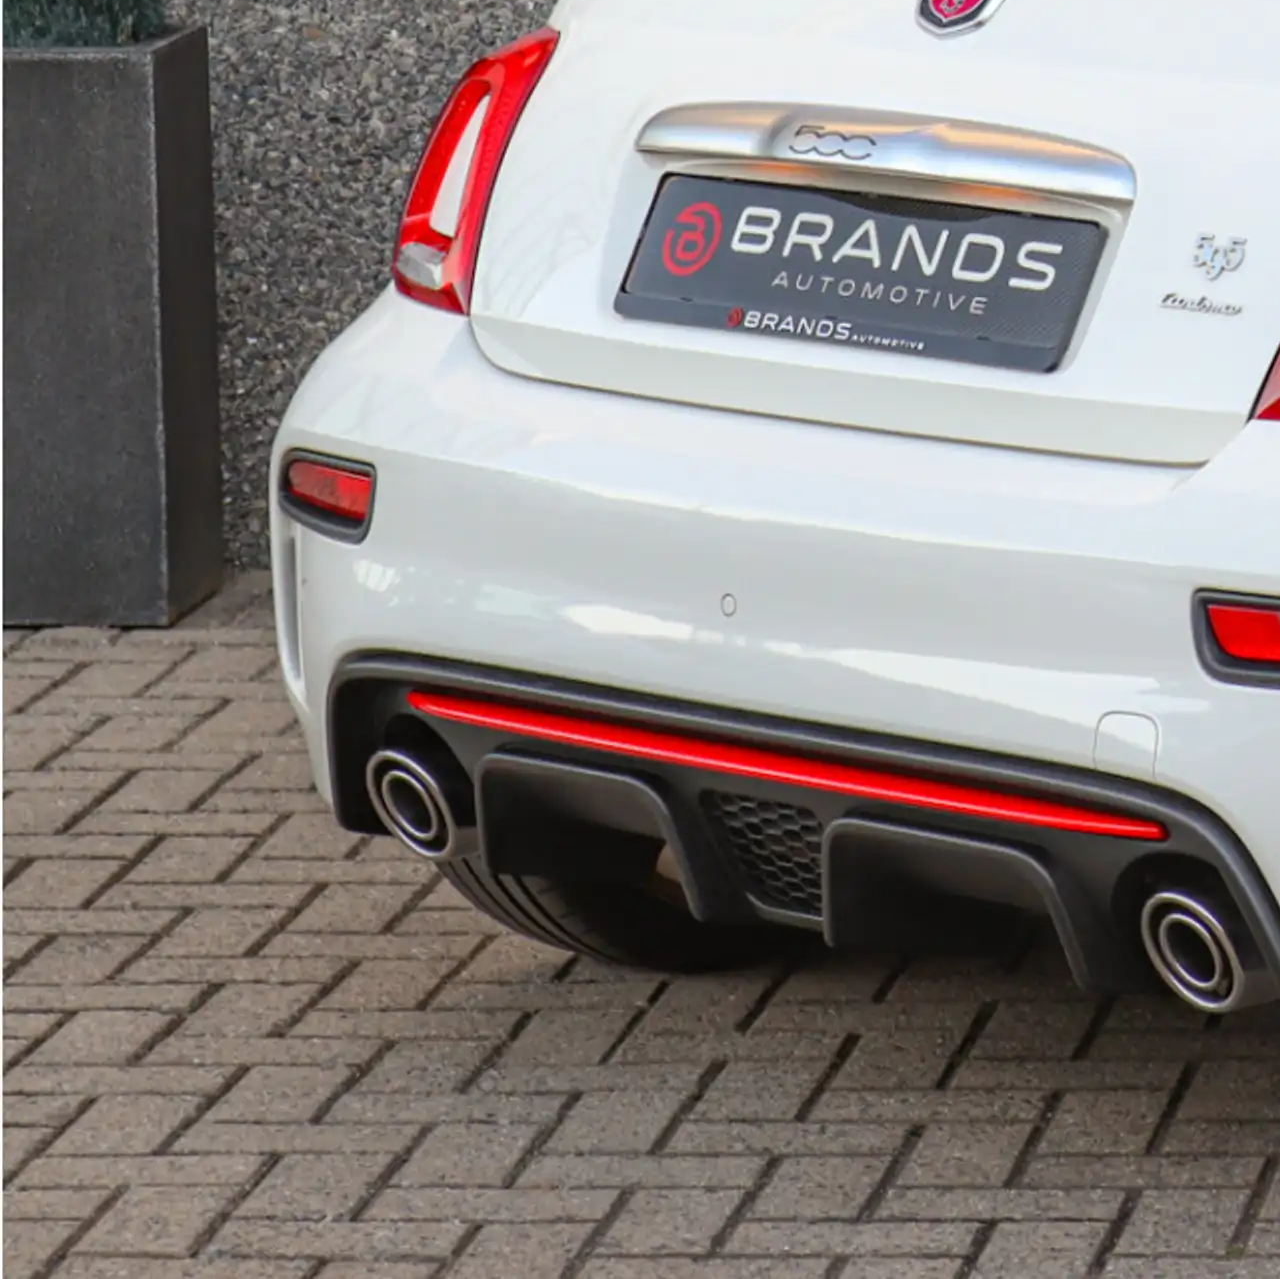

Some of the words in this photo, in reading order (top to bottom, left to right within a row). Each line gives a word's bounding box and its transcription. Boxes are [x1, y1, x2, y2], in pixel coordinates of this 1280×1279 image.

[730, 205, 1063, 292] BRANDS
[771, 271, 988, 316] AUTOMOTIVE
[743, 310, 851, 341] BRANDS
[851, 334, 924, 351] AUTOMOTIVE
